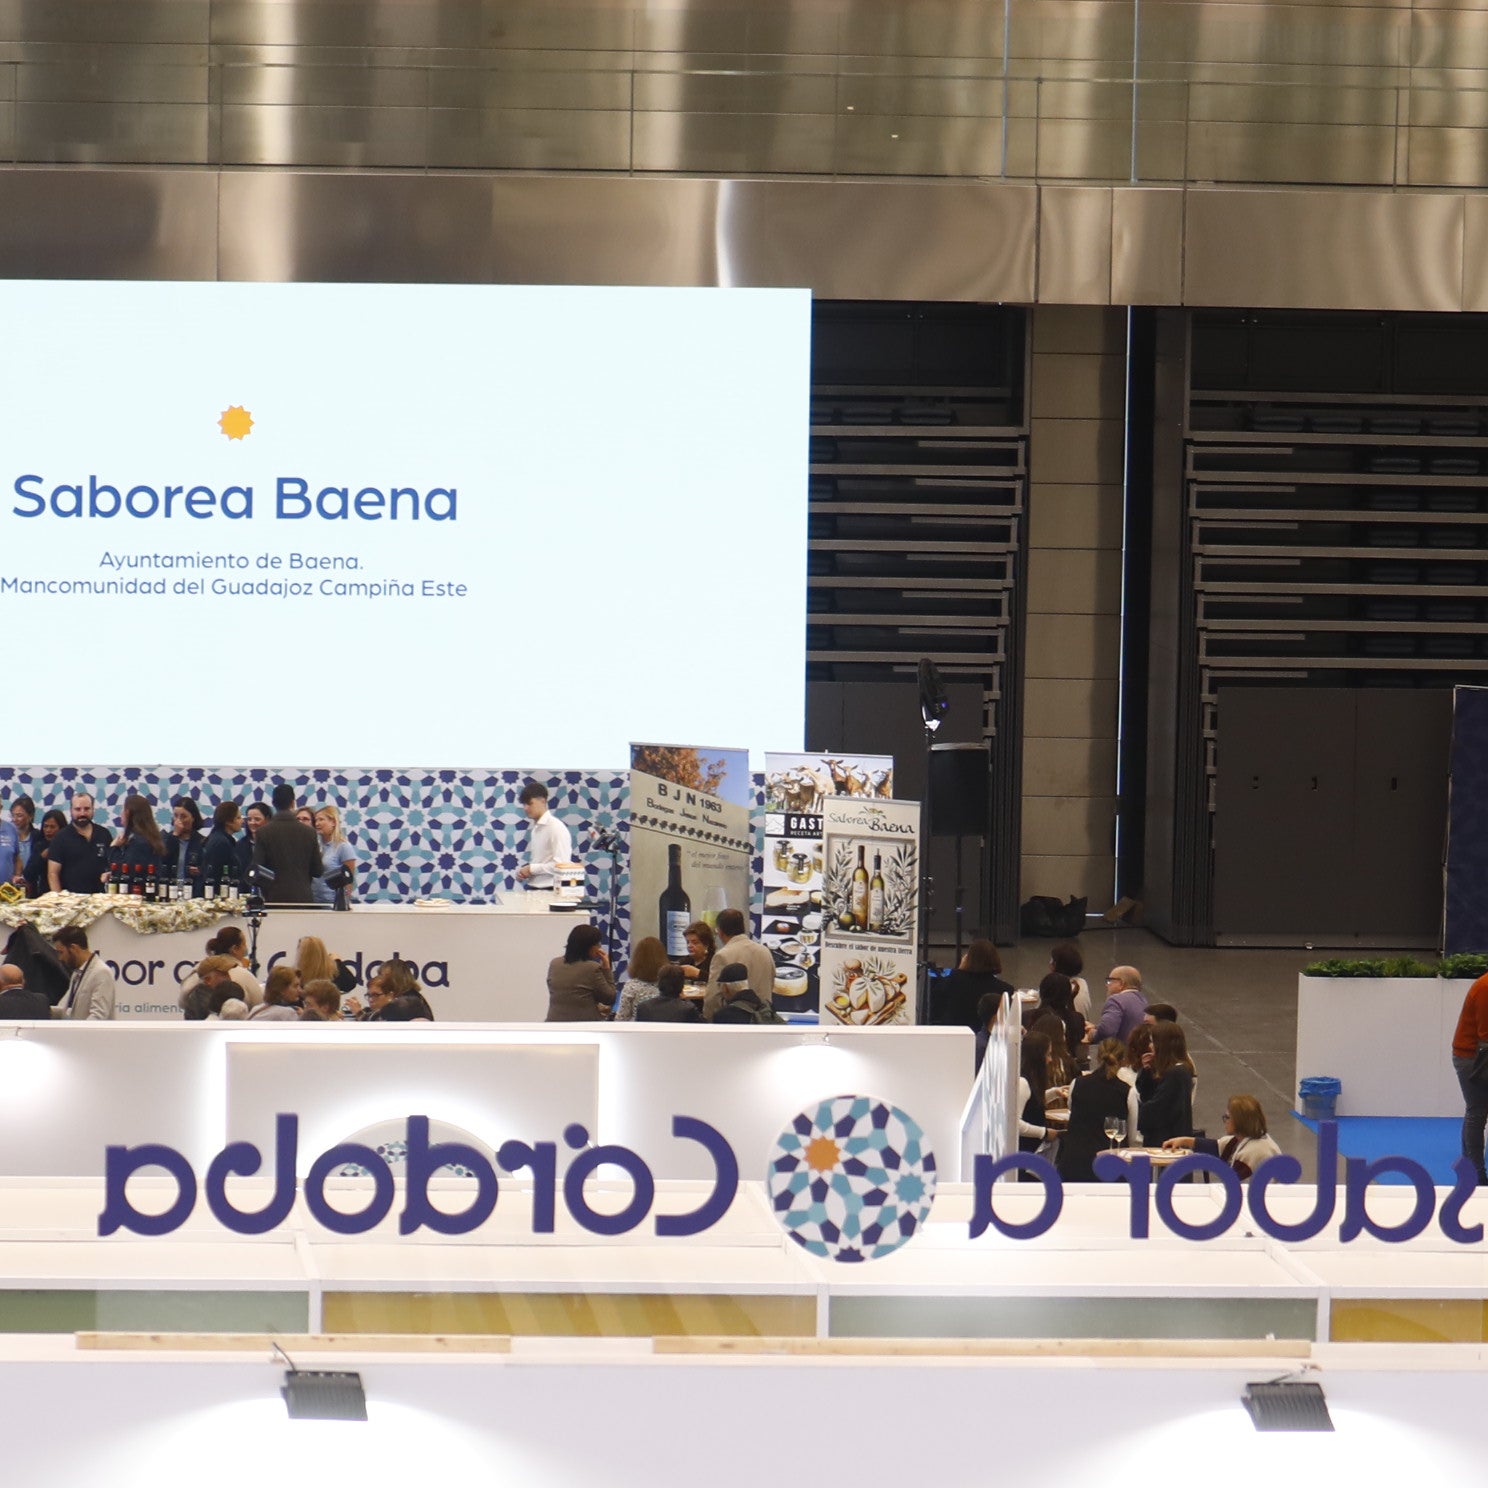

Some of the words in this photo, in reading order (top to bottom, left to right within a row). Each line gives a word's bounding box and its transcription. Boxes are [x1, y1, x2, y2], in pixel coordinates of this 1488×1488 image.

[12, 474, 254, 519] Saborea
[276, 476, 457, 520] Baena
[99, 551, 250, 571] Ayuntamiento
[256, 552, 283, 570] de
[289, 553, 364, 571] Baena.
[0, 577, 167, 595] Mancomunidad
[174, 578, 205, 596] del
[212, 579, 313, 600] Guadajoz
[319, 579, 415, 599] Campiña
[421, 580, 468, 598] Este
[658, 783, 668, 796] B
[673, 789, 681, 801] J
[686, 792, 696, 806] N
[700, 799, 722, 813] 1963
[868, 818, 916, 834] Baena
